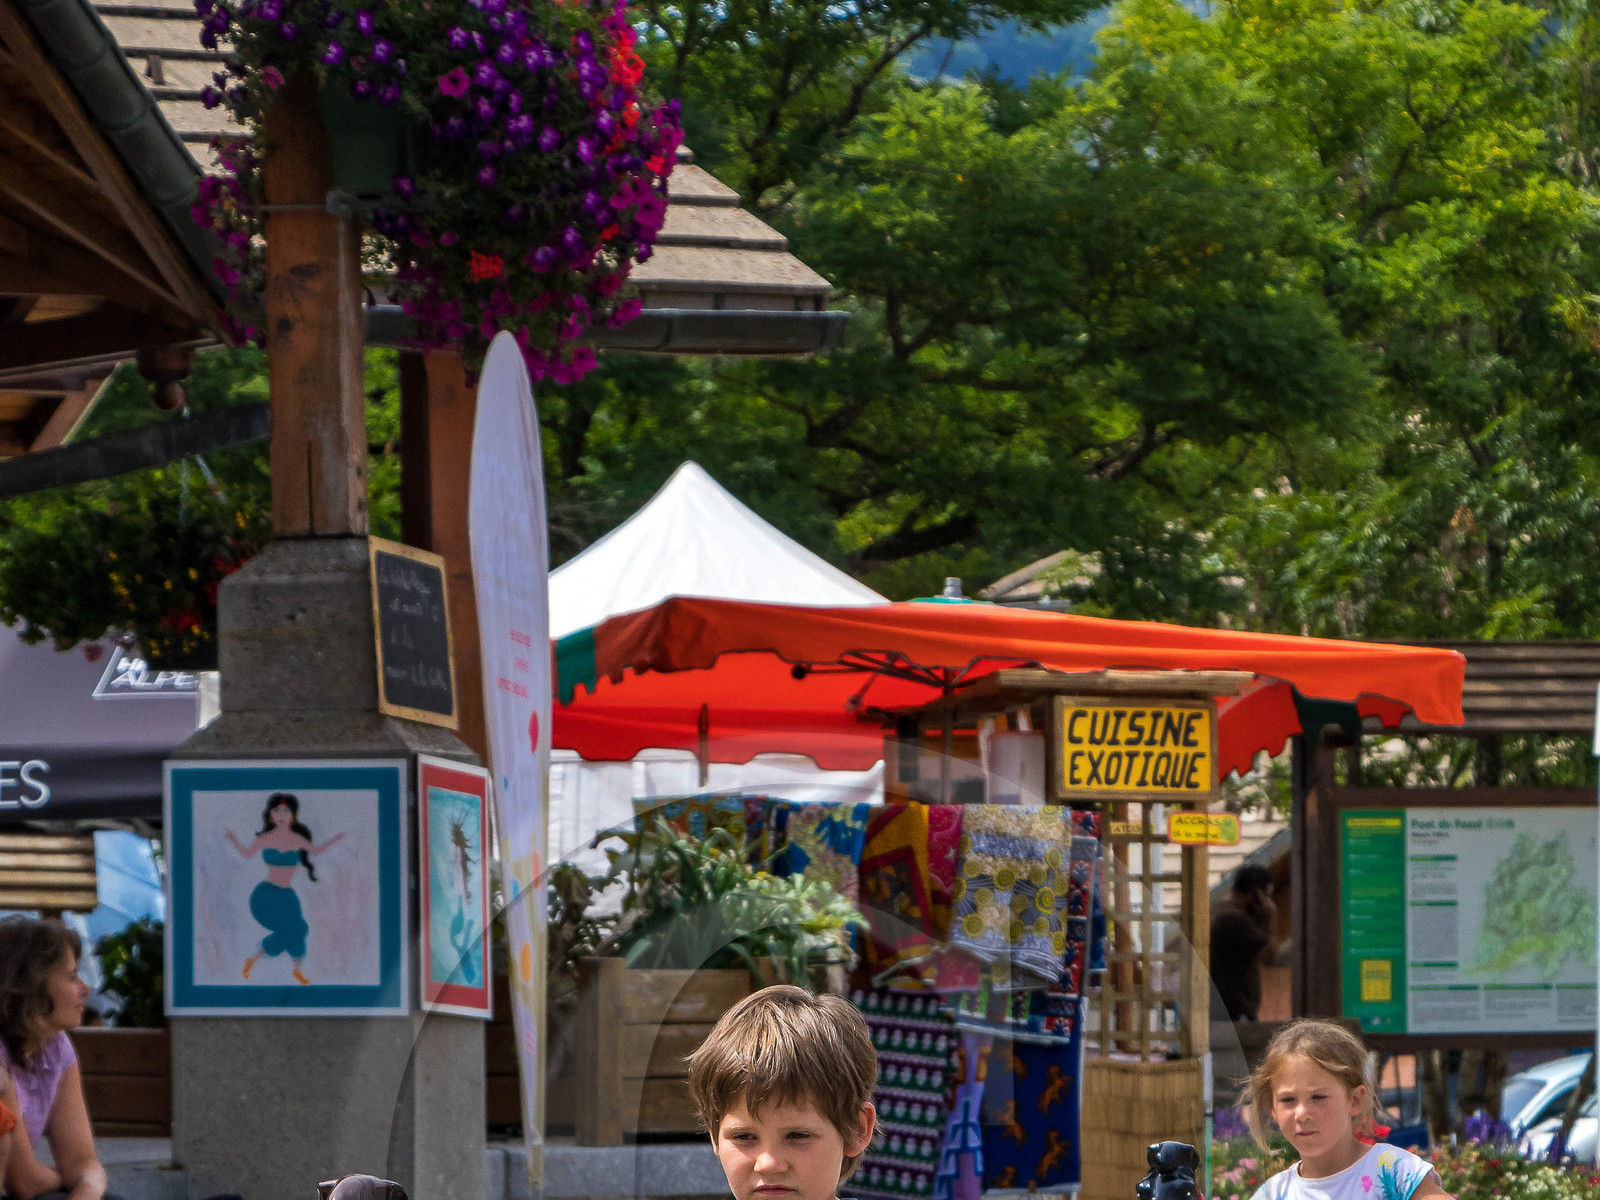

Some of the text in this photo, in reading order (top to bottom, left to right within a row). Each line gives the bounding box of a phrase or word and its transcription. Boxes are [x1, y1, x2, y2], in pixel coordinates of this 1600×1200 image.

[1068, 708, 1204, 747] CUISINE
[1069, 749, 1207, 789] EXOTIQUE
[1175, 815, 1222, 826] ACCRAS
